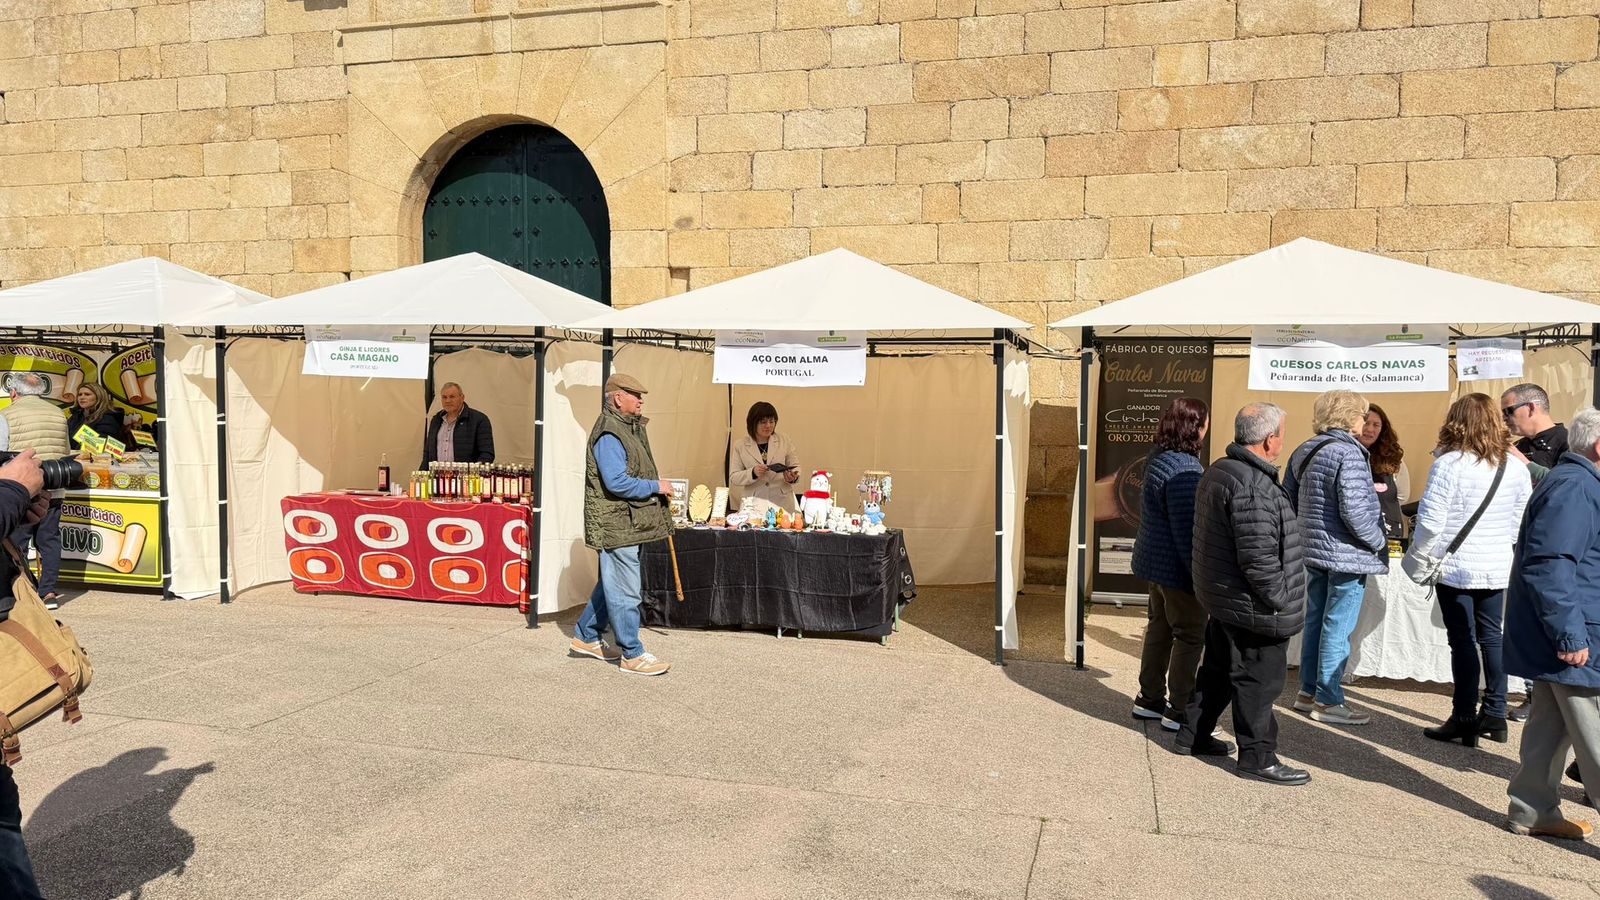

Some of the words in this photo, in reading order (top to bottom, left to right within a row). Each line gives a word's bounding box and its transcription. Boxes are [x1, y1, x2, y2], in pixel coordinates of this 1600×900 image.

[1105, 344, 1147, 354] FÁBRICA
[1150, 345, 1164, 354] DE
[1167, 345, 1208, 354] QUESOS
[9, 345, 81, 368] encurtidos
[330, 353, 355, 361] CASA
[358, 353, 399, 362] MAGANO
[751, 355, 772, 364] AÇO
[774, 355, 797, 363] COM
[799, 355, 829, 363] ALMA
[1270, 359, 1322, 370] QUESOS
[1326, 360, 1378, 369] CARLOS
[1382, 359, 1426, 369] NAVAS
[765, 368, 815, 377] PORTUGAL
[1104, 360, 1153, 383] Carlos
[1156, 359, 1207, 383] Navas
[1270, 372, 1323, 383] Peñaranda
[1325, 373, 1337, 382] de
[1340, 373, 1359, 383] Bte.
[1361, 373, 1424, 383] (Salamanca)
[1105, 409, 1160, 423] Cincho
[1108, 433, 1131, 442] ORO
[1133, 434, 1154, 443] 2024
[61, 504, 124, 526] encurtidos
